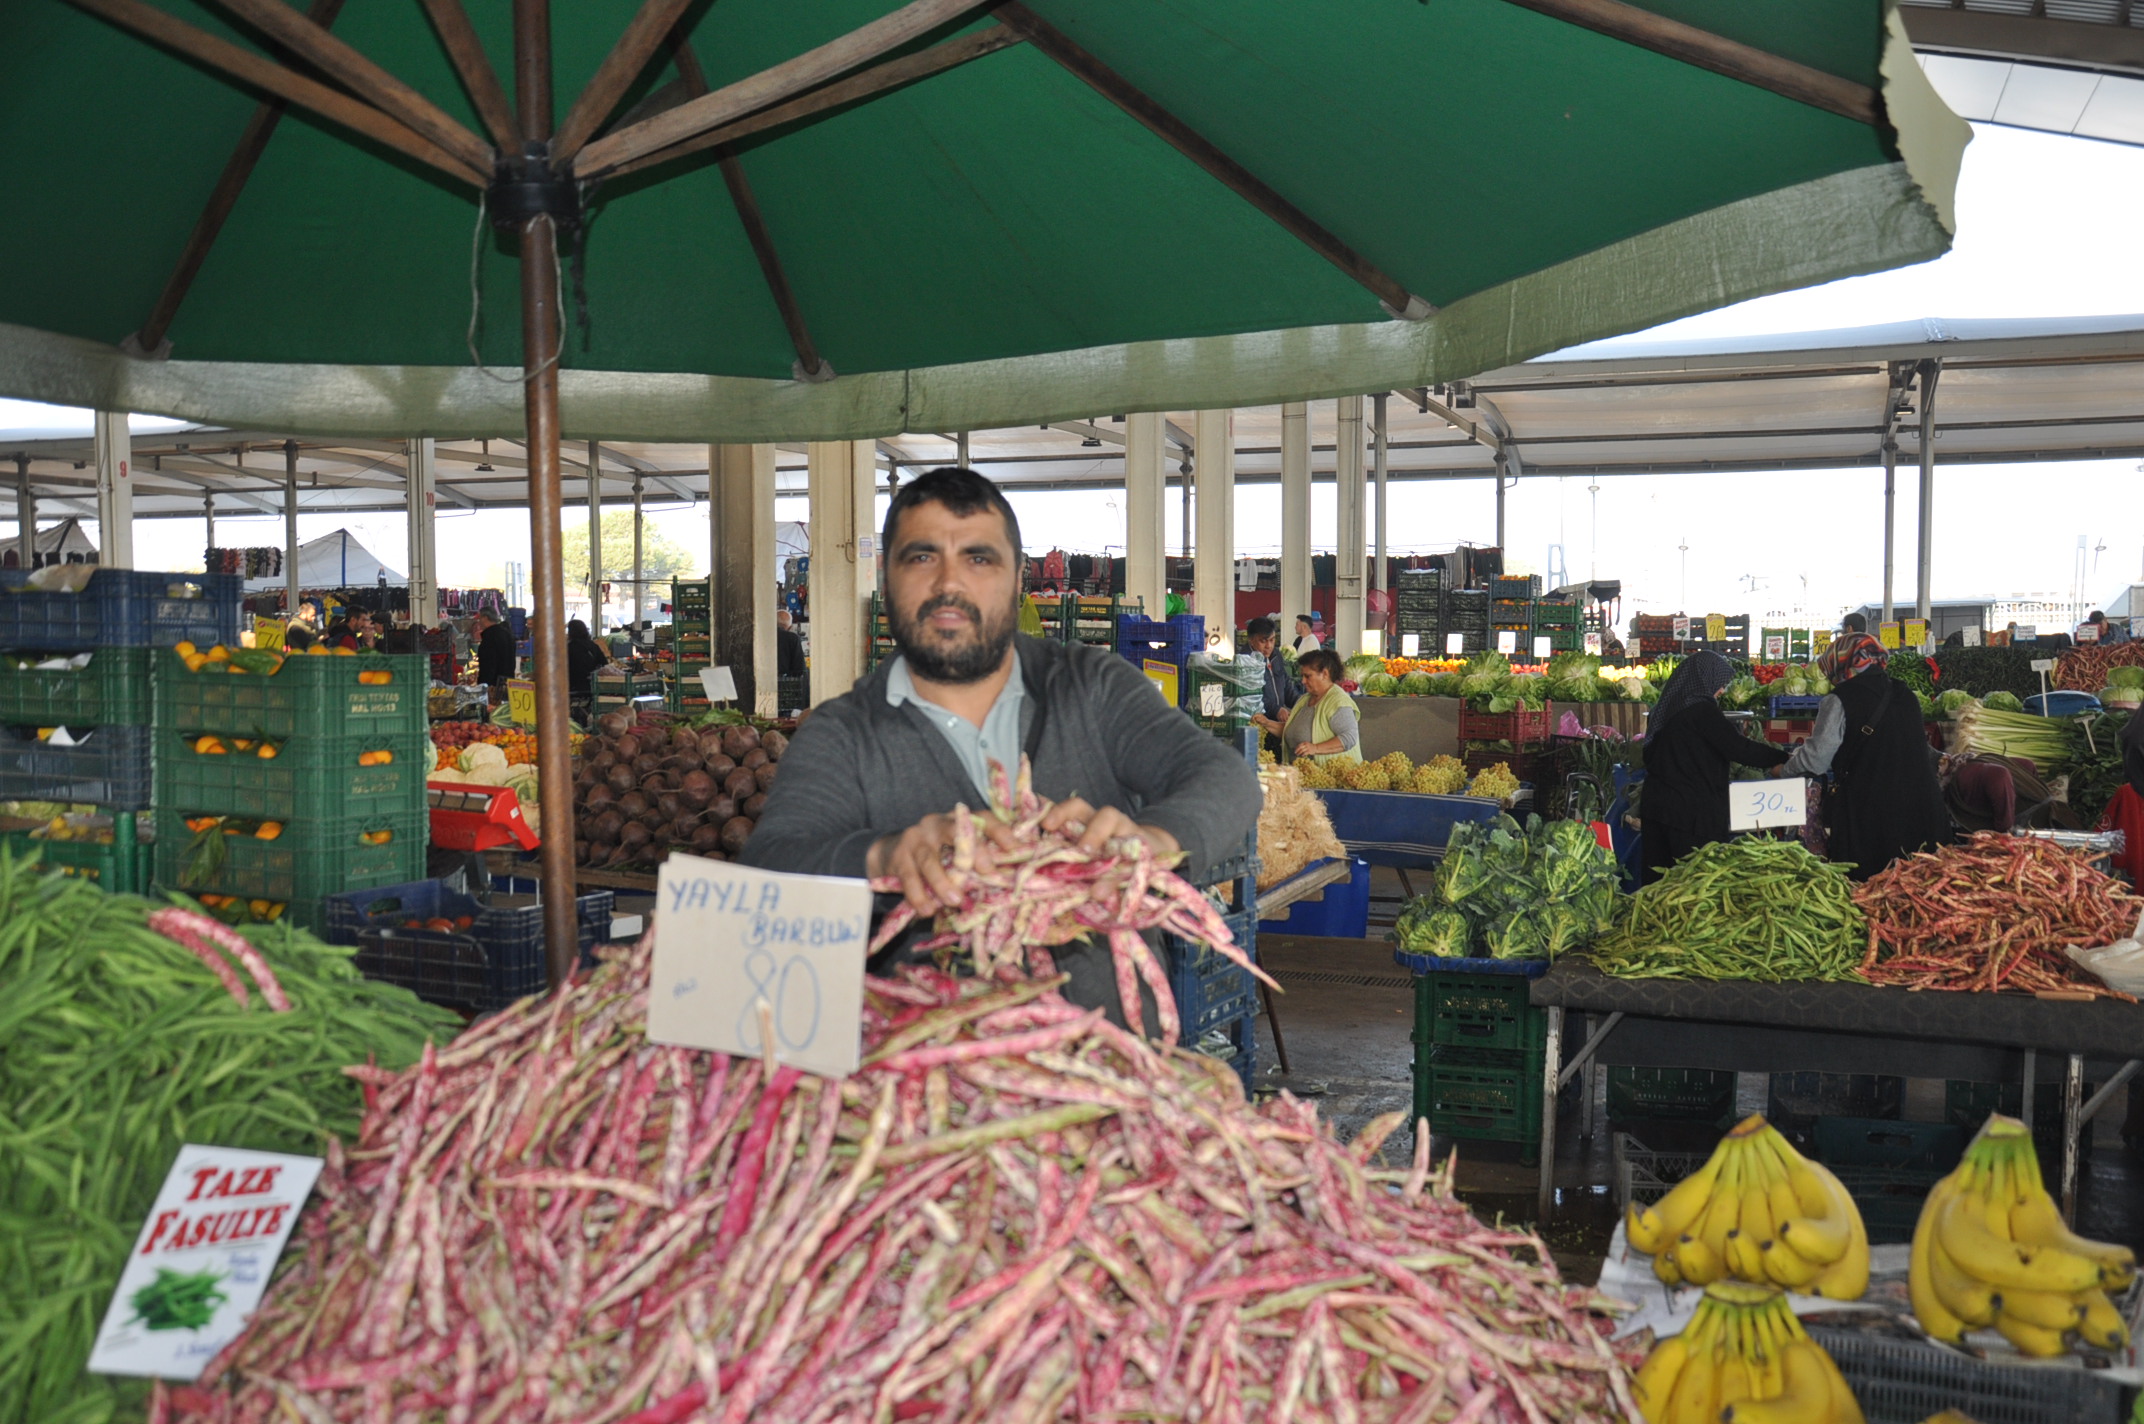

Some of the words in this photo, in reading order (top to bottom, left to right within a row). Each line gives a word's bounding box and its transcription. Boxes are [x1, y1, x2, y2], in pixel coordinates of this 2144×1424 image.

[119, 460, 127, 478] 9
[425, 491, 435, 507] 10
[511, 690, 532, 712] 50
[1745, 791, 1784, 817] 30
[669, 878, 781, 914] YAYLA
[736, 946, 822, 1053] 80
[187, 1165, 282, 1201] TAZE
[141, 1204, 291, 1254] FASULYE
